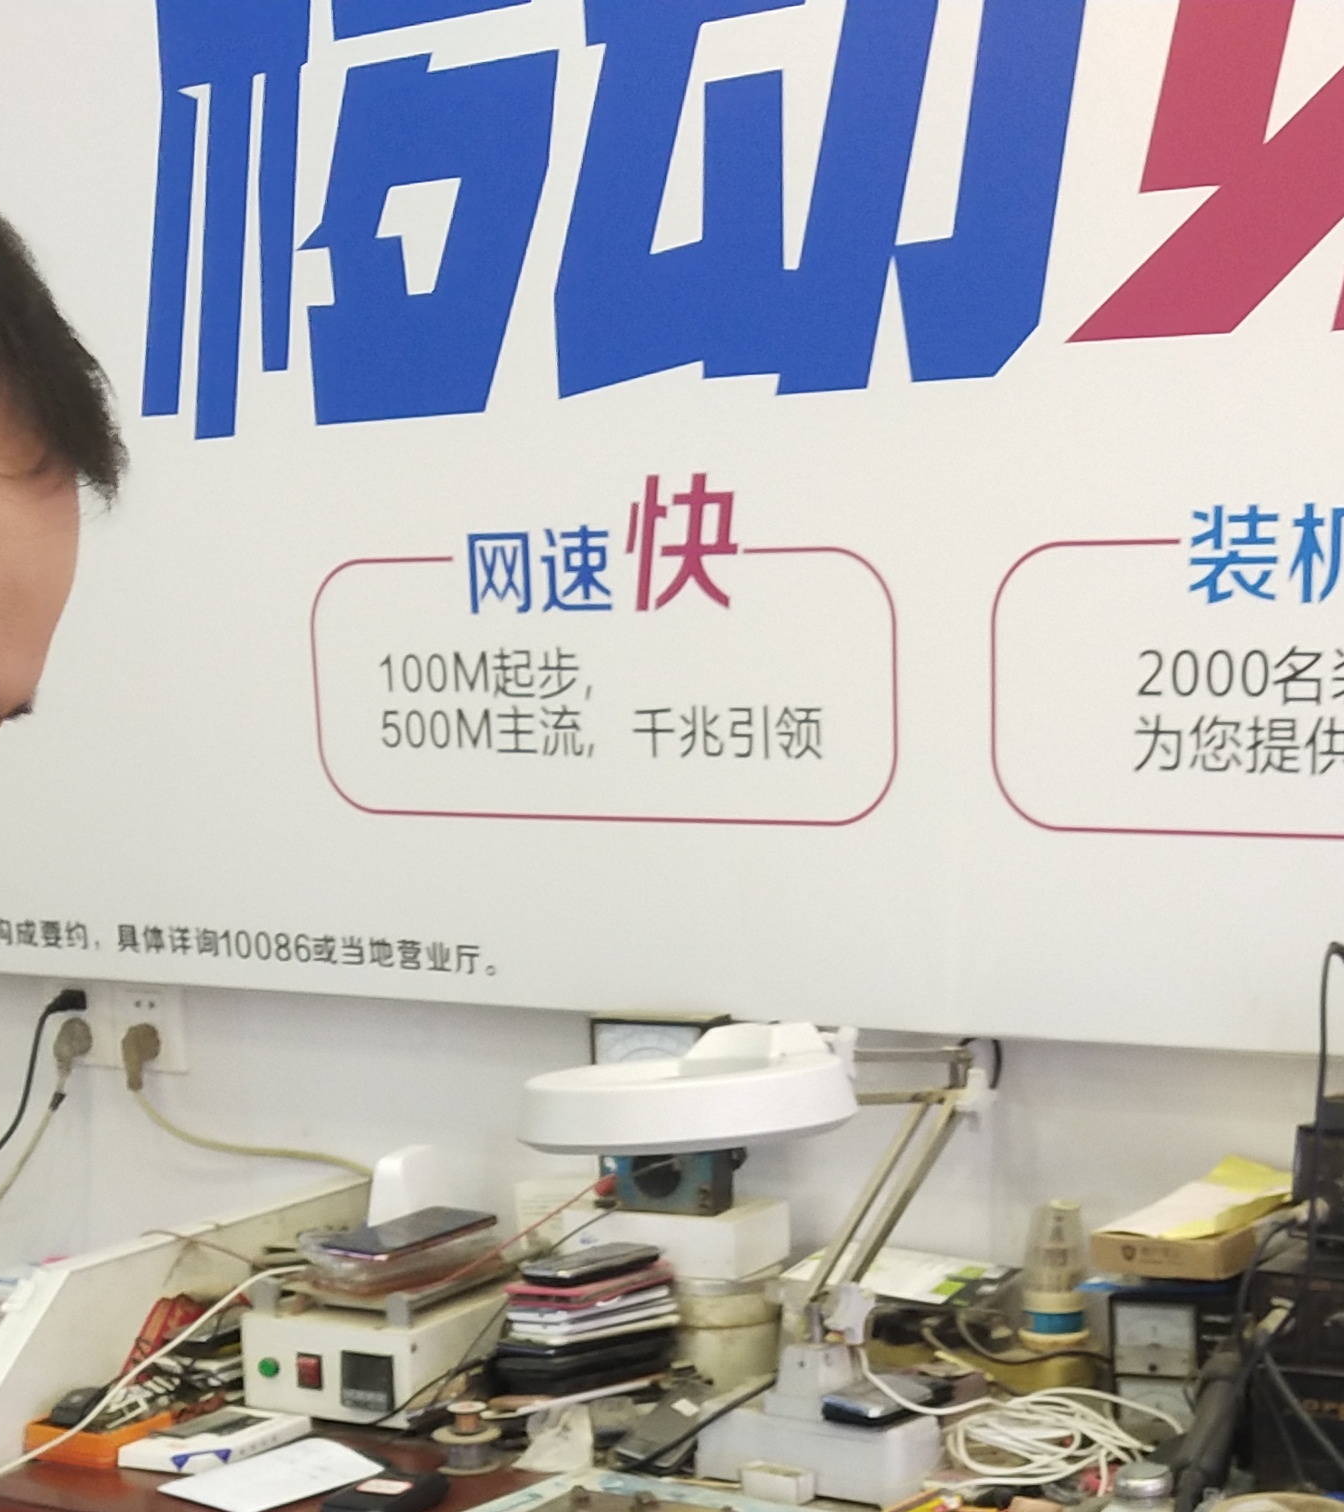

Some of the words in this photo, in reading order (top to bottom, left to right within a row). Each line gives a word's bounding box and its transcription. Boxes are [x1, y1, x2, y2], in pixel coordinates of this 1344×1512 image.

[466, 472, 739, 614] 网速快
[378, 646, 593, 701] 100M起步，
